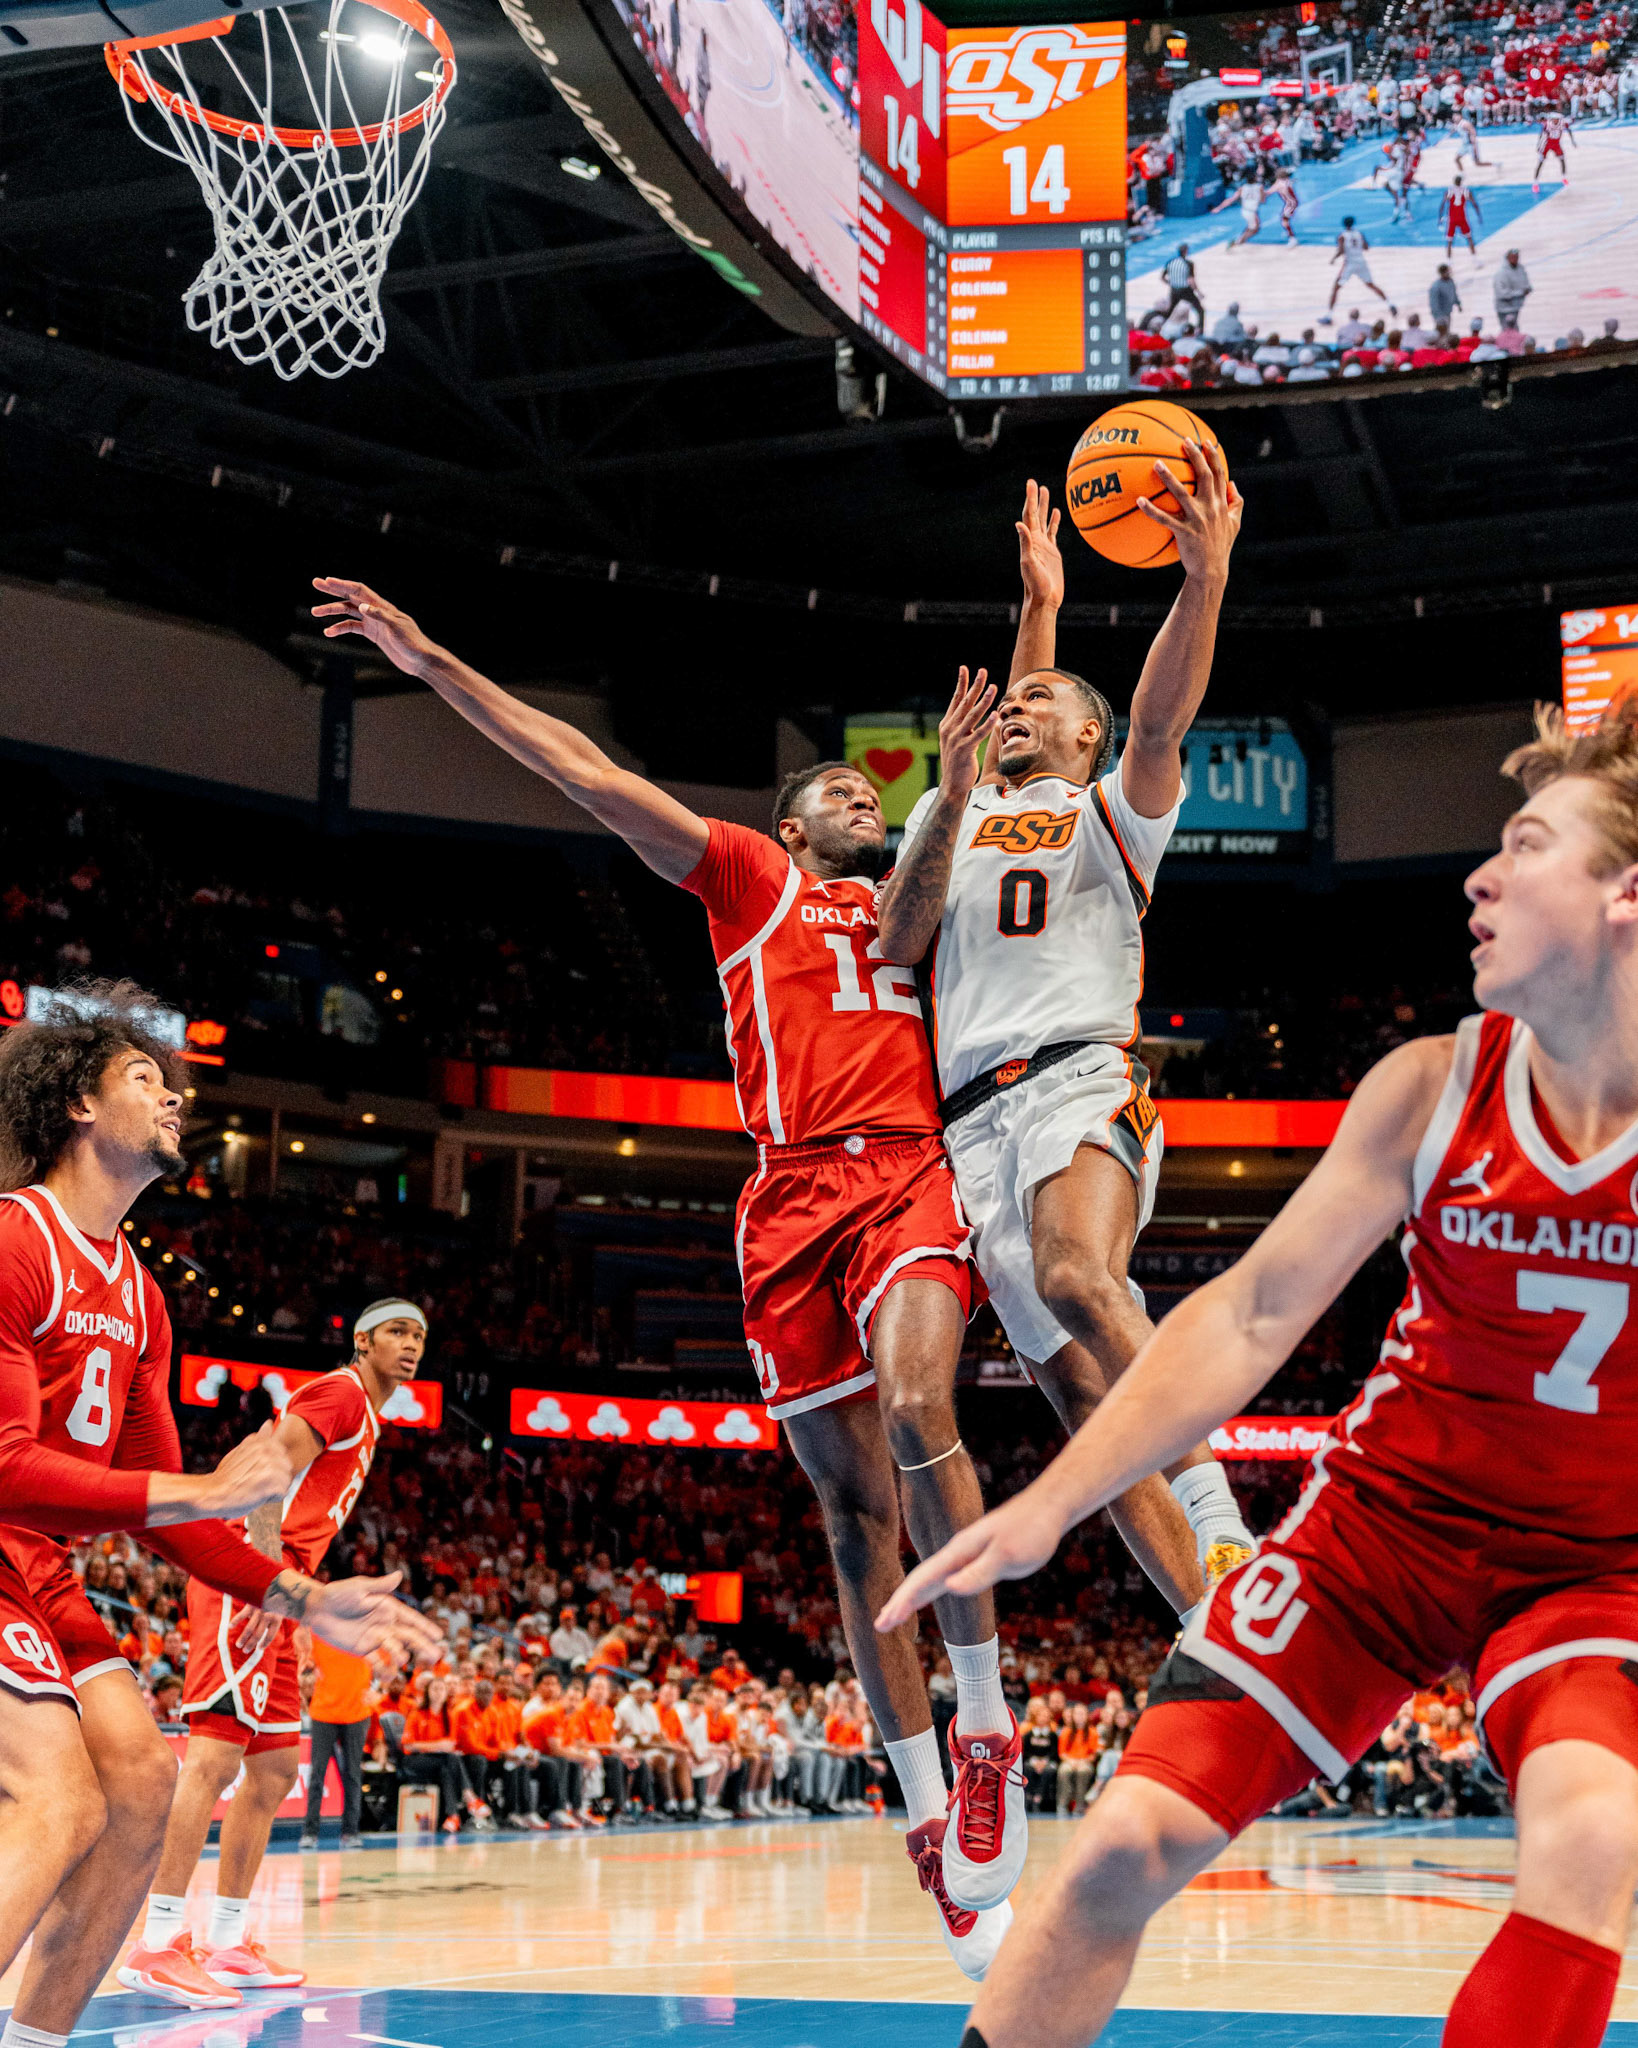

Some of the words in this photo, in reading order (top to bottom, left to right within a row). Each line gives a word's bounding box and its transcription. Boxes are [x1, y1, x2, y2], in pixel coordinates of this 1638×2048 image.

[946, 24, 1127, 131] OSU
[884, 94, 921, 188] 14
[1003, 144, 1070, 216] 14
[952, 232, 998, 249] PLAYER
[1080, 228, 1105, 244] PTS
[1107, 227, 1123, 243] FL
[1018, 377, 1030, 393] 2
[1051, 375, 1073, 392] 1ST
[1070, 472, 1122, 511] NCAA
[969, 808, 1081, 855] OSU
[1221, 836, 1278, 854] NOW
[801, 905, 878, 928] OKLA
[998, 869, 1049, 938] 0
[824, 933, 923, 1020] 12
[1517, 1269, 1630, 1414] 7
[65, 1346, 112, 1447] 8
[1230, 1552, 1309, 1656] OU
[2, 1622, 62, 1680] OU
